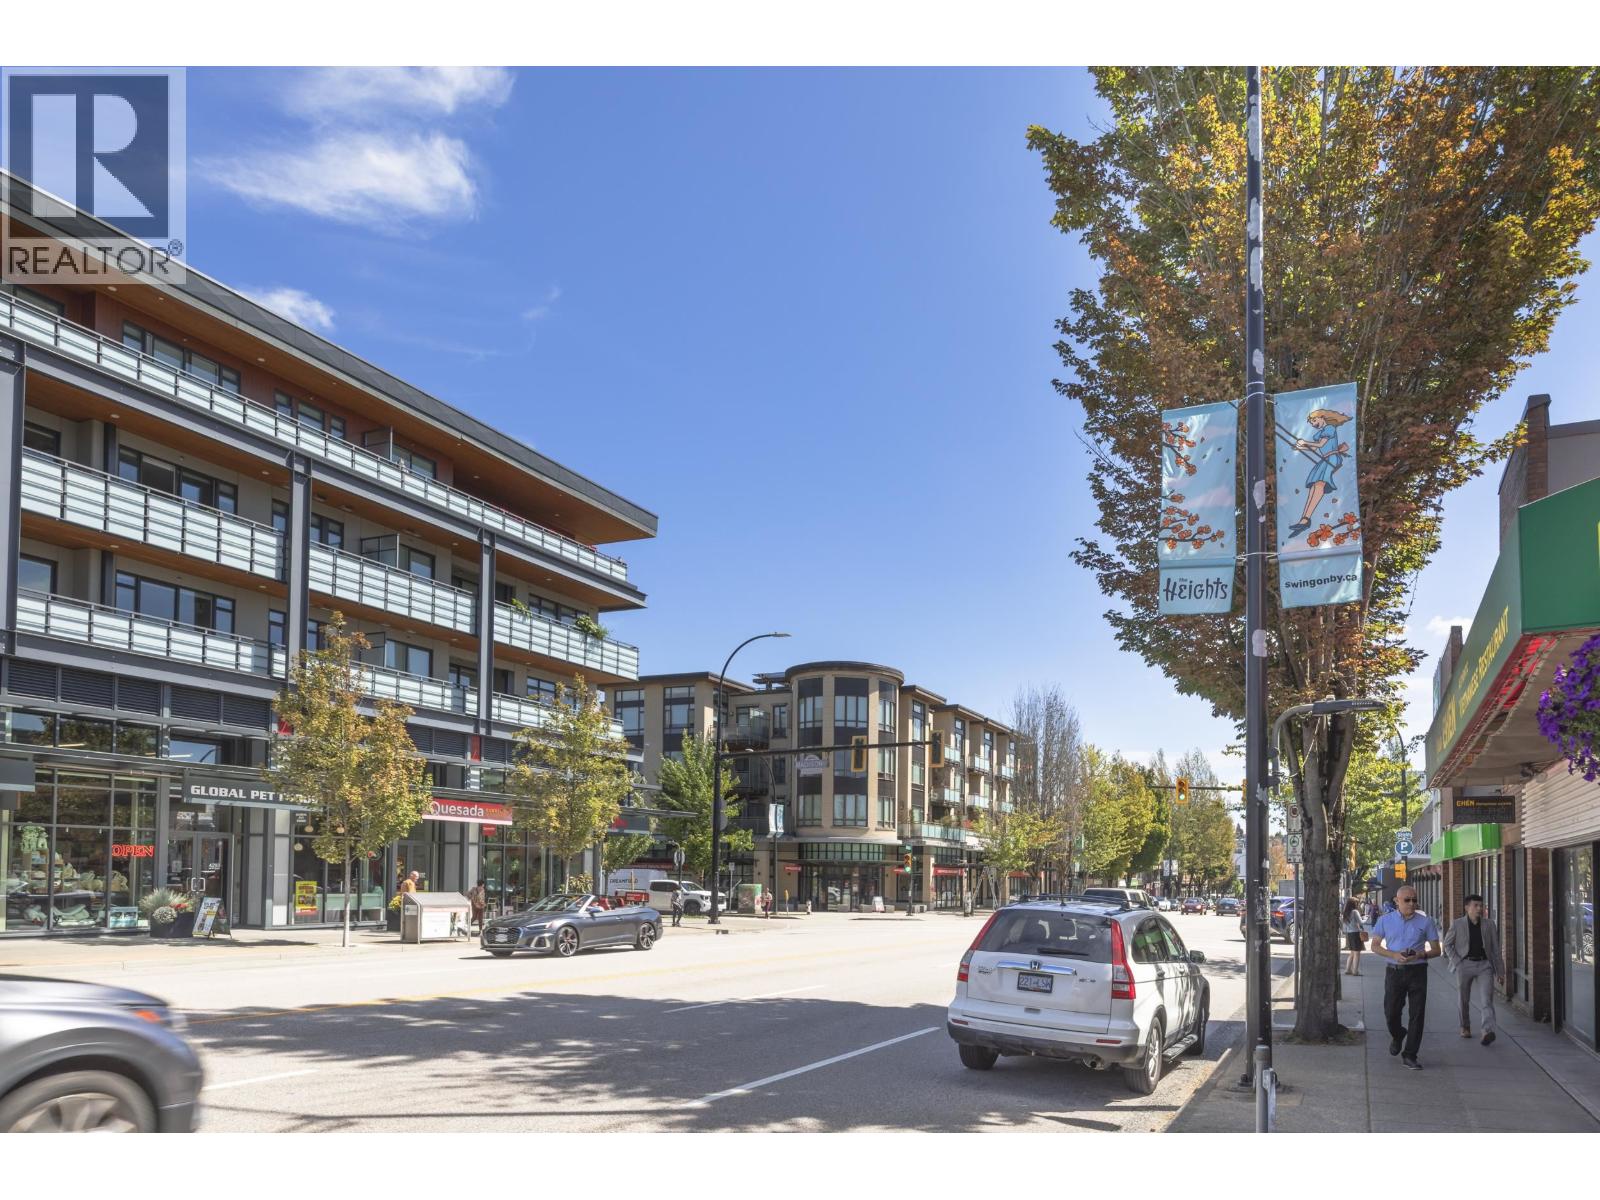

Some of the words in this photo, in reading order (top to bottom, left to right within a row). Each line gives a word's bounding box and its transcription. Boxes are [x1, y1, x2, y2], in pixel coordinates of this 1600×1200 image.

[1284, 573, 1358, 589] swingonby.ca
[1478, 604, 1509, 682] RESTAURANT
[190, 785, 247, 799] GLOBAL
[250, 790, 276, 801] PET
[429, 800, 484, 817] Quesada
[111, 843, 155, 858] OPEN
